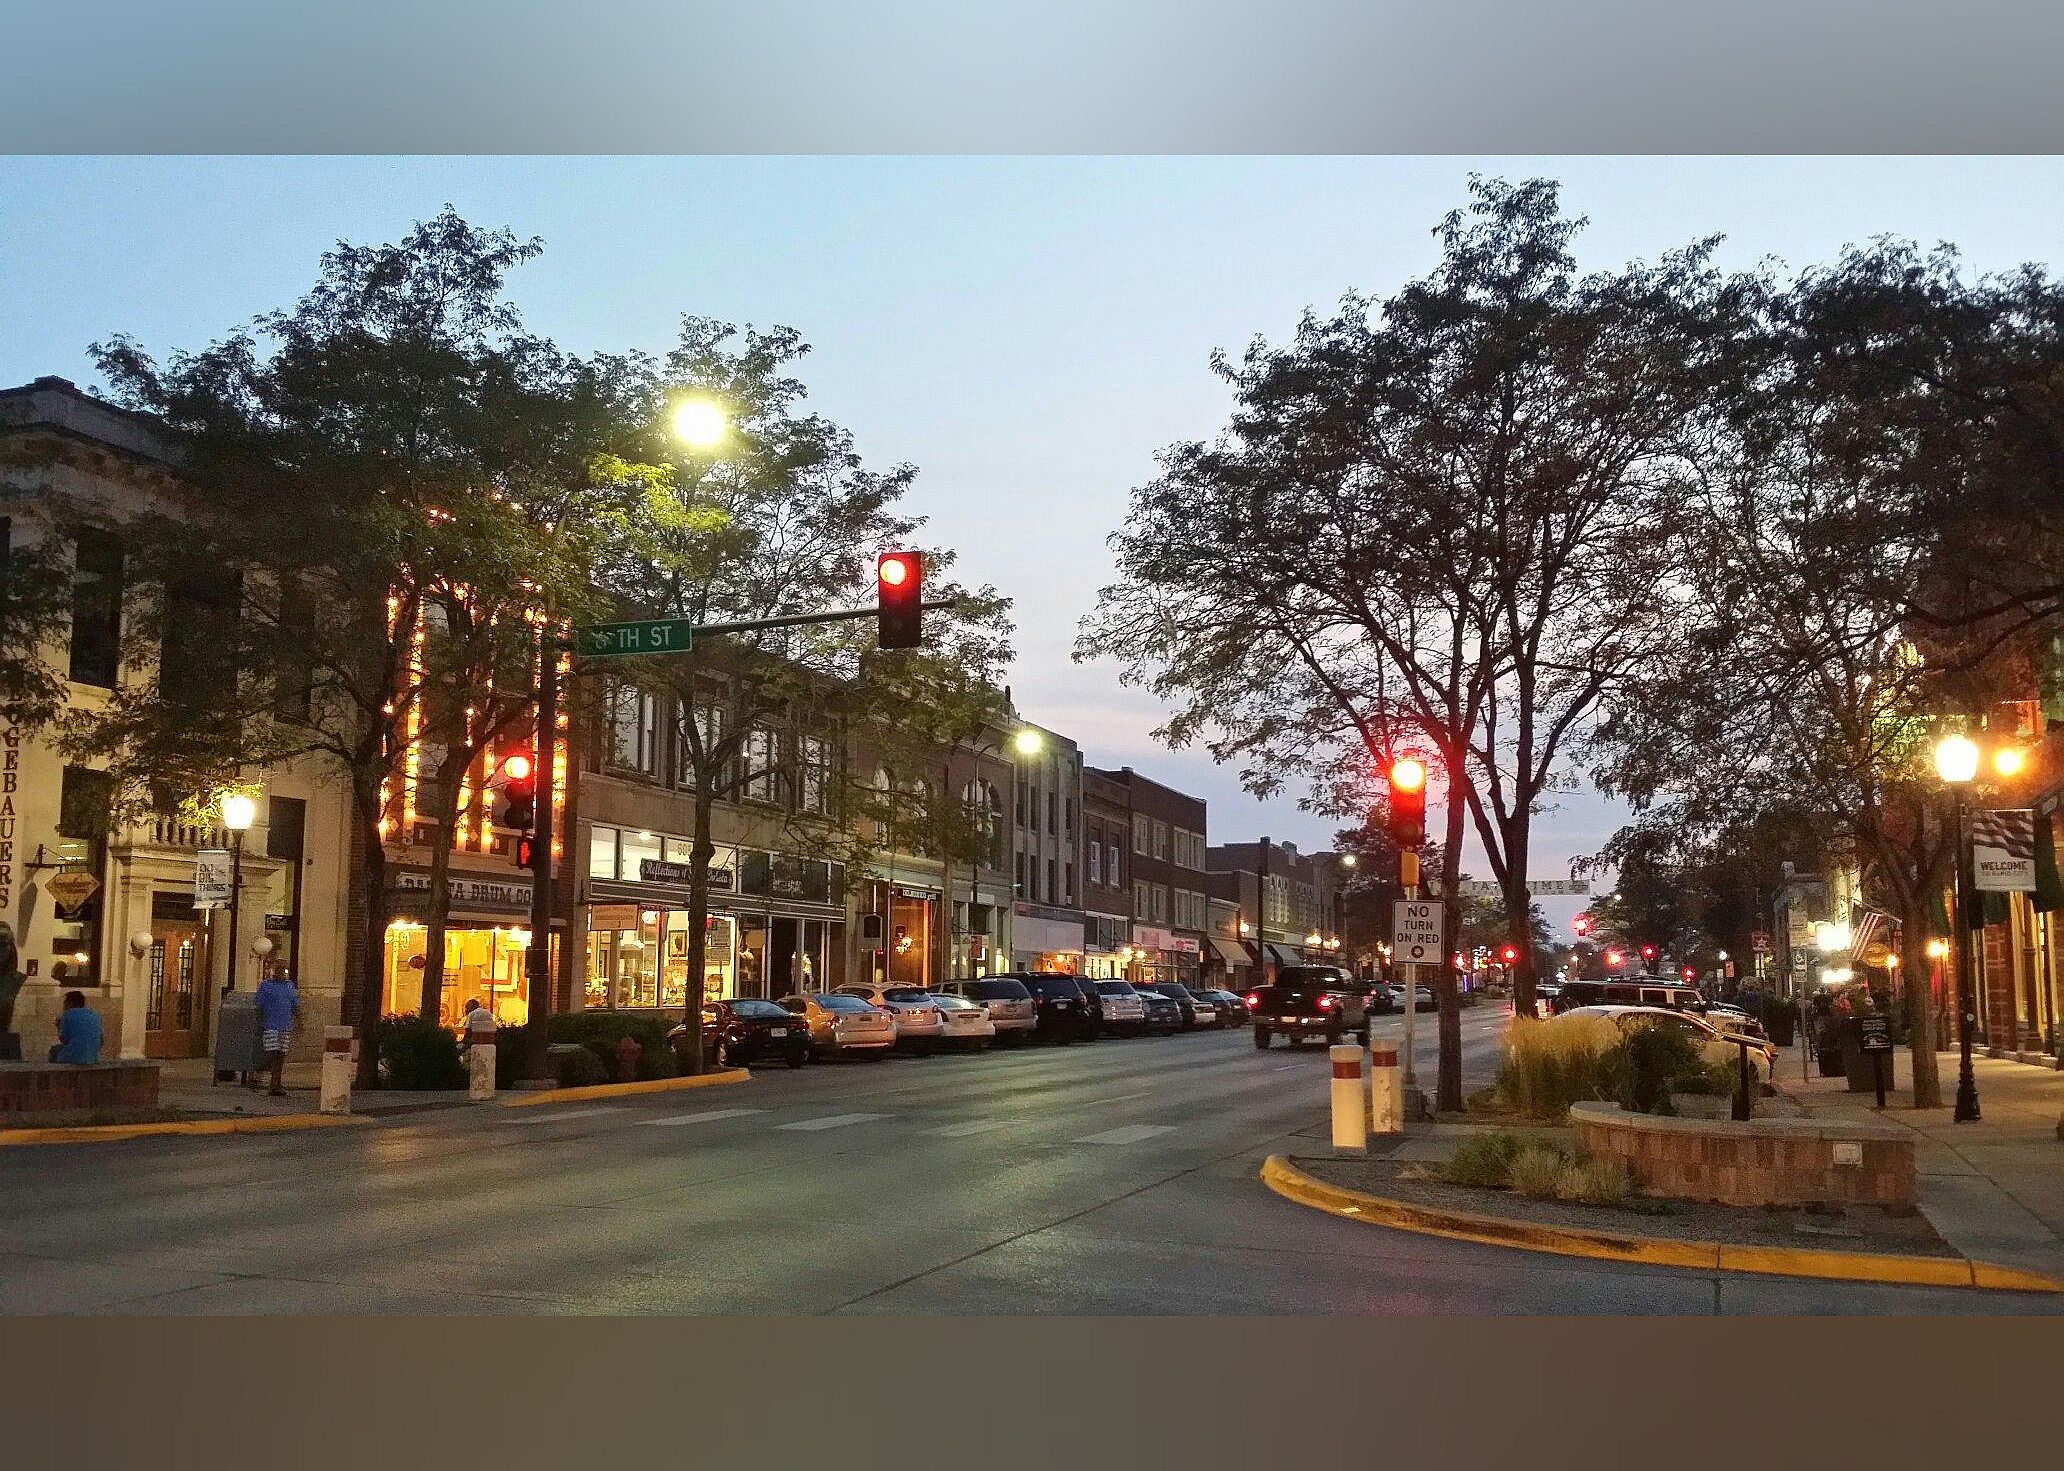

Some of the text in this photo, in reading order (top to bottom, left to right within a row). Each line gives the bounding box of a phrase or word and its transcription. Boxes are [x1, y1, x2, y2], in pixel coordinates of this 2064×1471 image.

[650, 625, 673, 647] ST
[1980, 861, 2028, 871] WELCOME
[472, 883, 512, 903] DRUM
[1407, 905, 1429, 918] NO
[1404, 920, 1433, 931] TURN
[1397, 932, 1439, 944] ON RED
